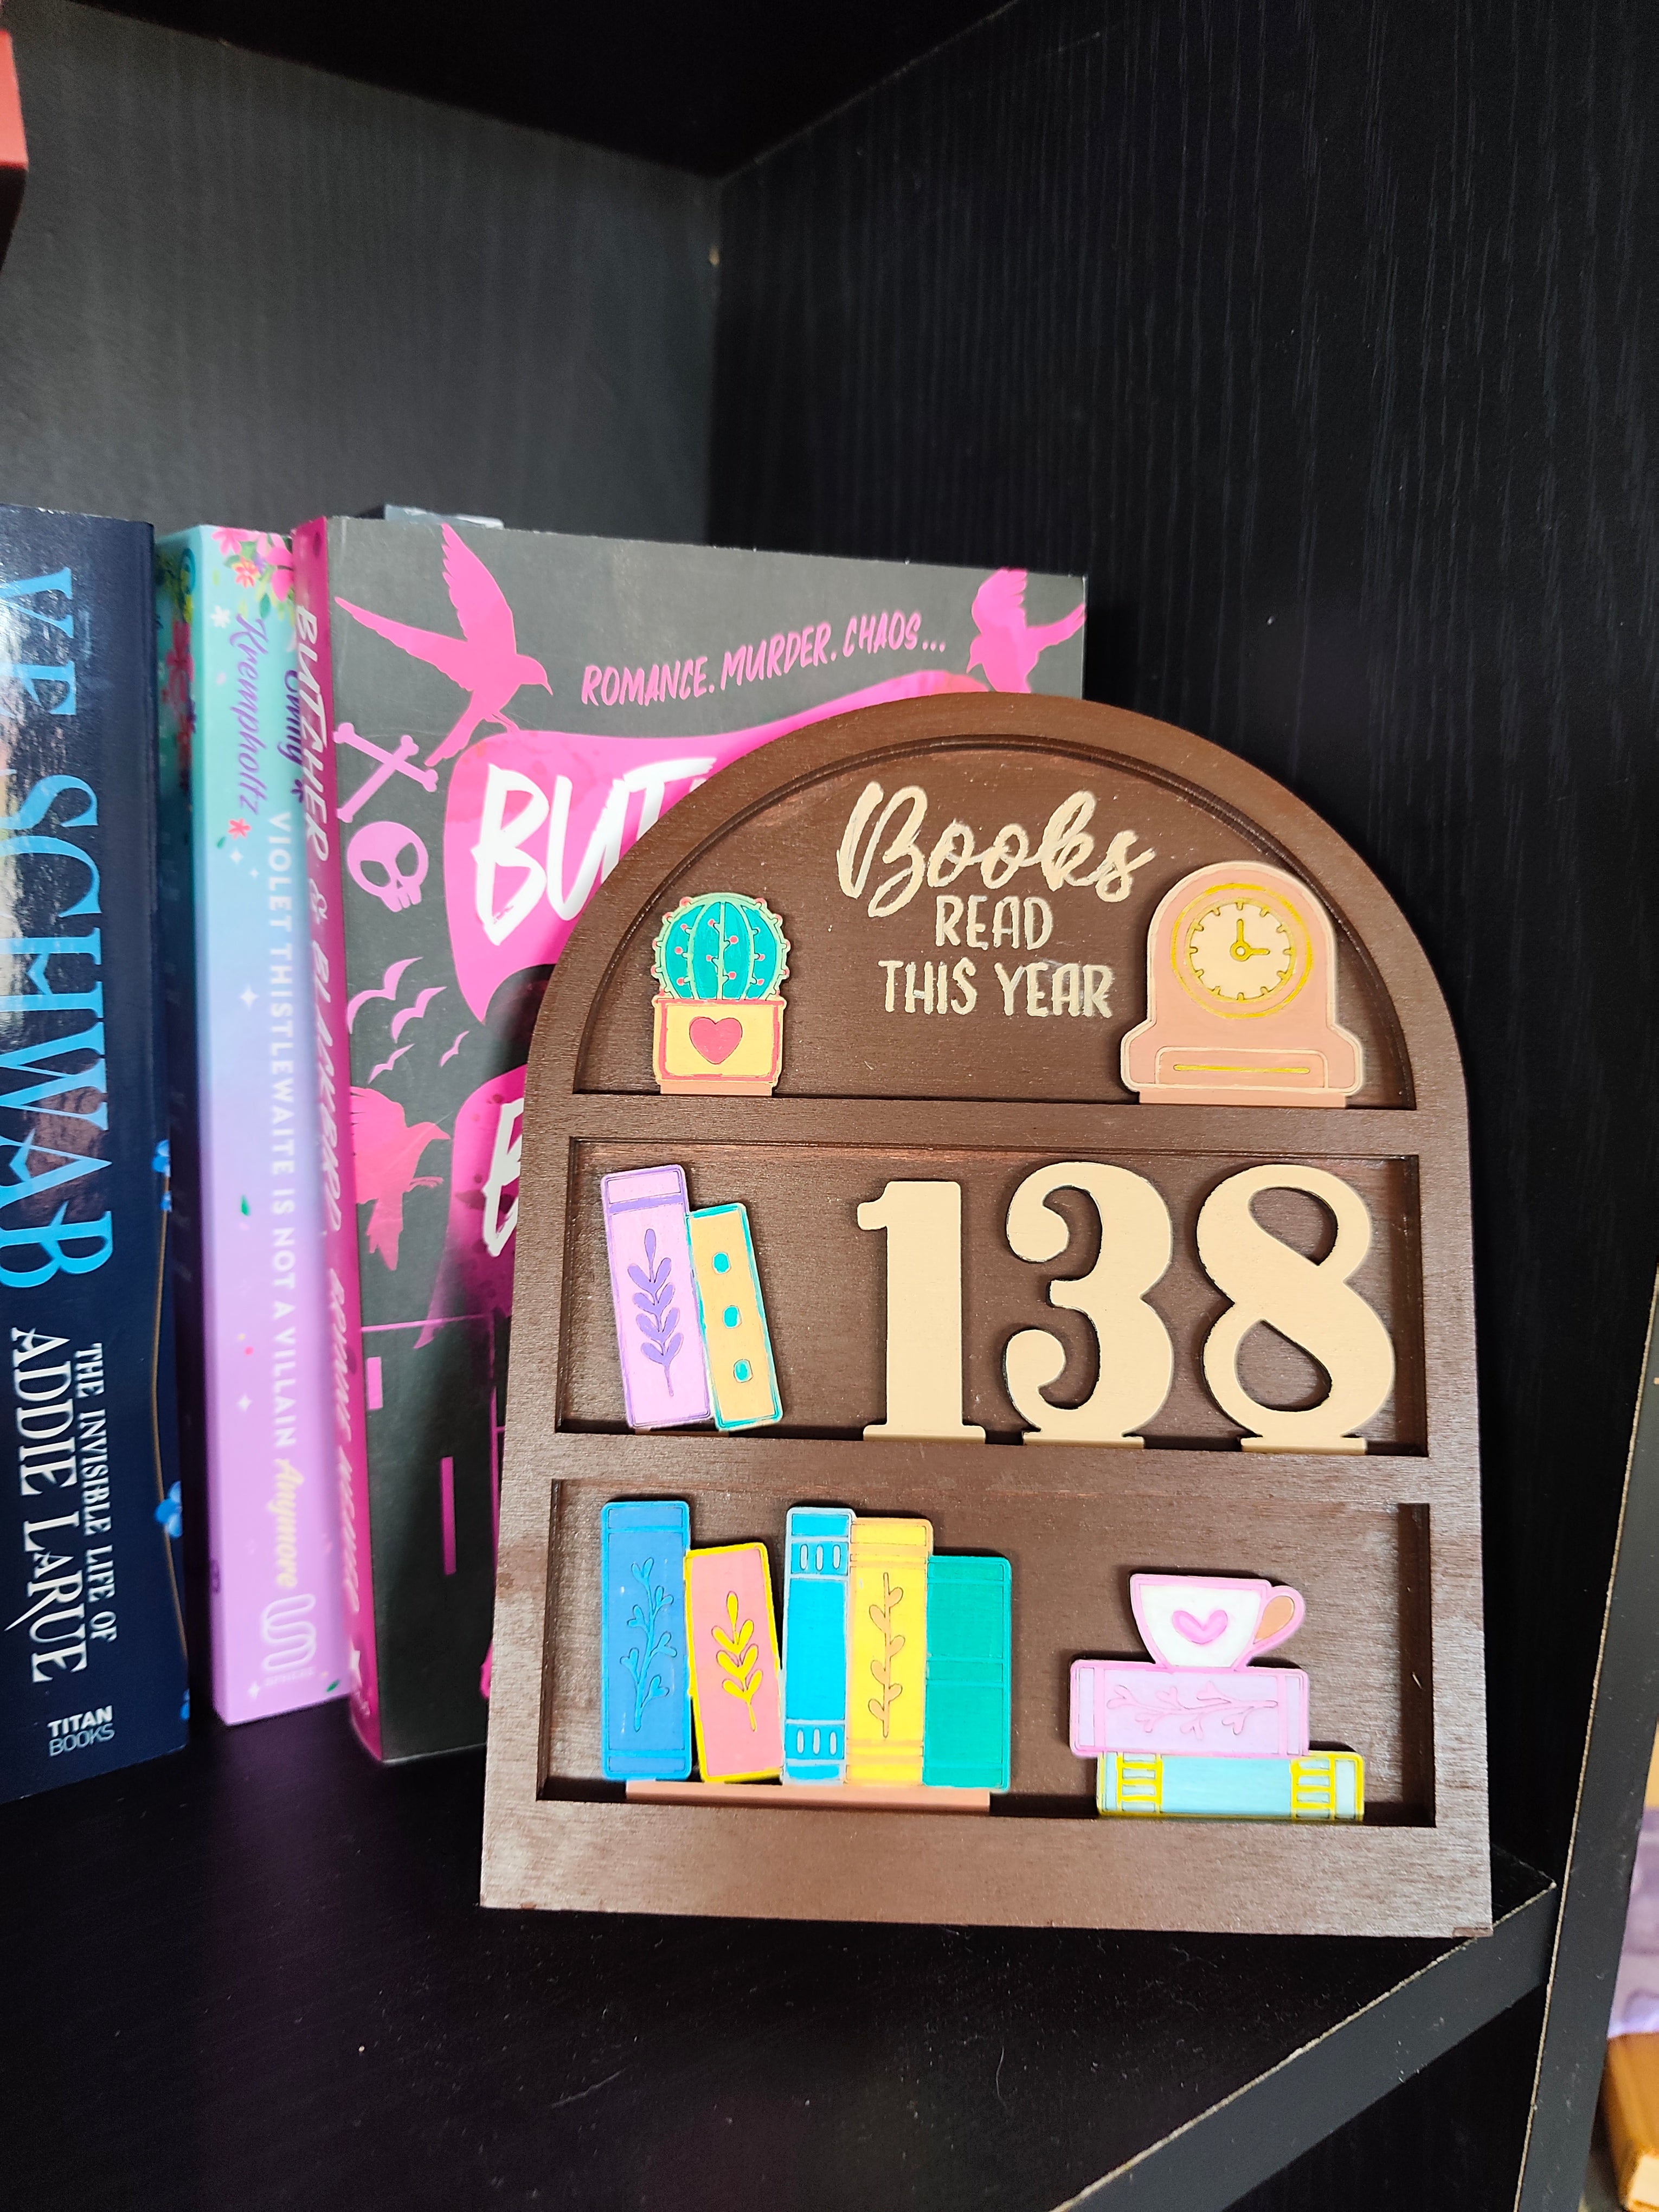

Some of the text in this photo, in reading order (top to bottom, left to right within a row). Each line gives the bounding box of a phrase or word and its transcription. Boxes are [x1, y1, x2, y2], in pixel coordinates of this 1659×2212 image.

[229, 613, 269, 815] Krempholtz
[581, 608, 946, 706] ROMANCE. MURDER. CHAOS...
[297, 605, 342, 1232] BUTCHER & BLACKBIRD
[836, 781, 1156, 917] Books
[935, 895, 1053, 951] READ
[0, 769, 113, 1288] SCHWAB
[878, 959, 1115, 1020] THIS YEAR
[268, 811, 305, 1589] VIOLET THISTLEWAITE IS NOT A VILLAIN Anymore
[857, 1160, 1397, 1452] 138
[10, 1327, 78, 1496] ADDIE
[75, 1342, 117, 1642] THE INVISIBLE LIFE OF
[47, 1705, 113, 1738] TITAN
[49, 1723, 115, 1757] BOOKS
